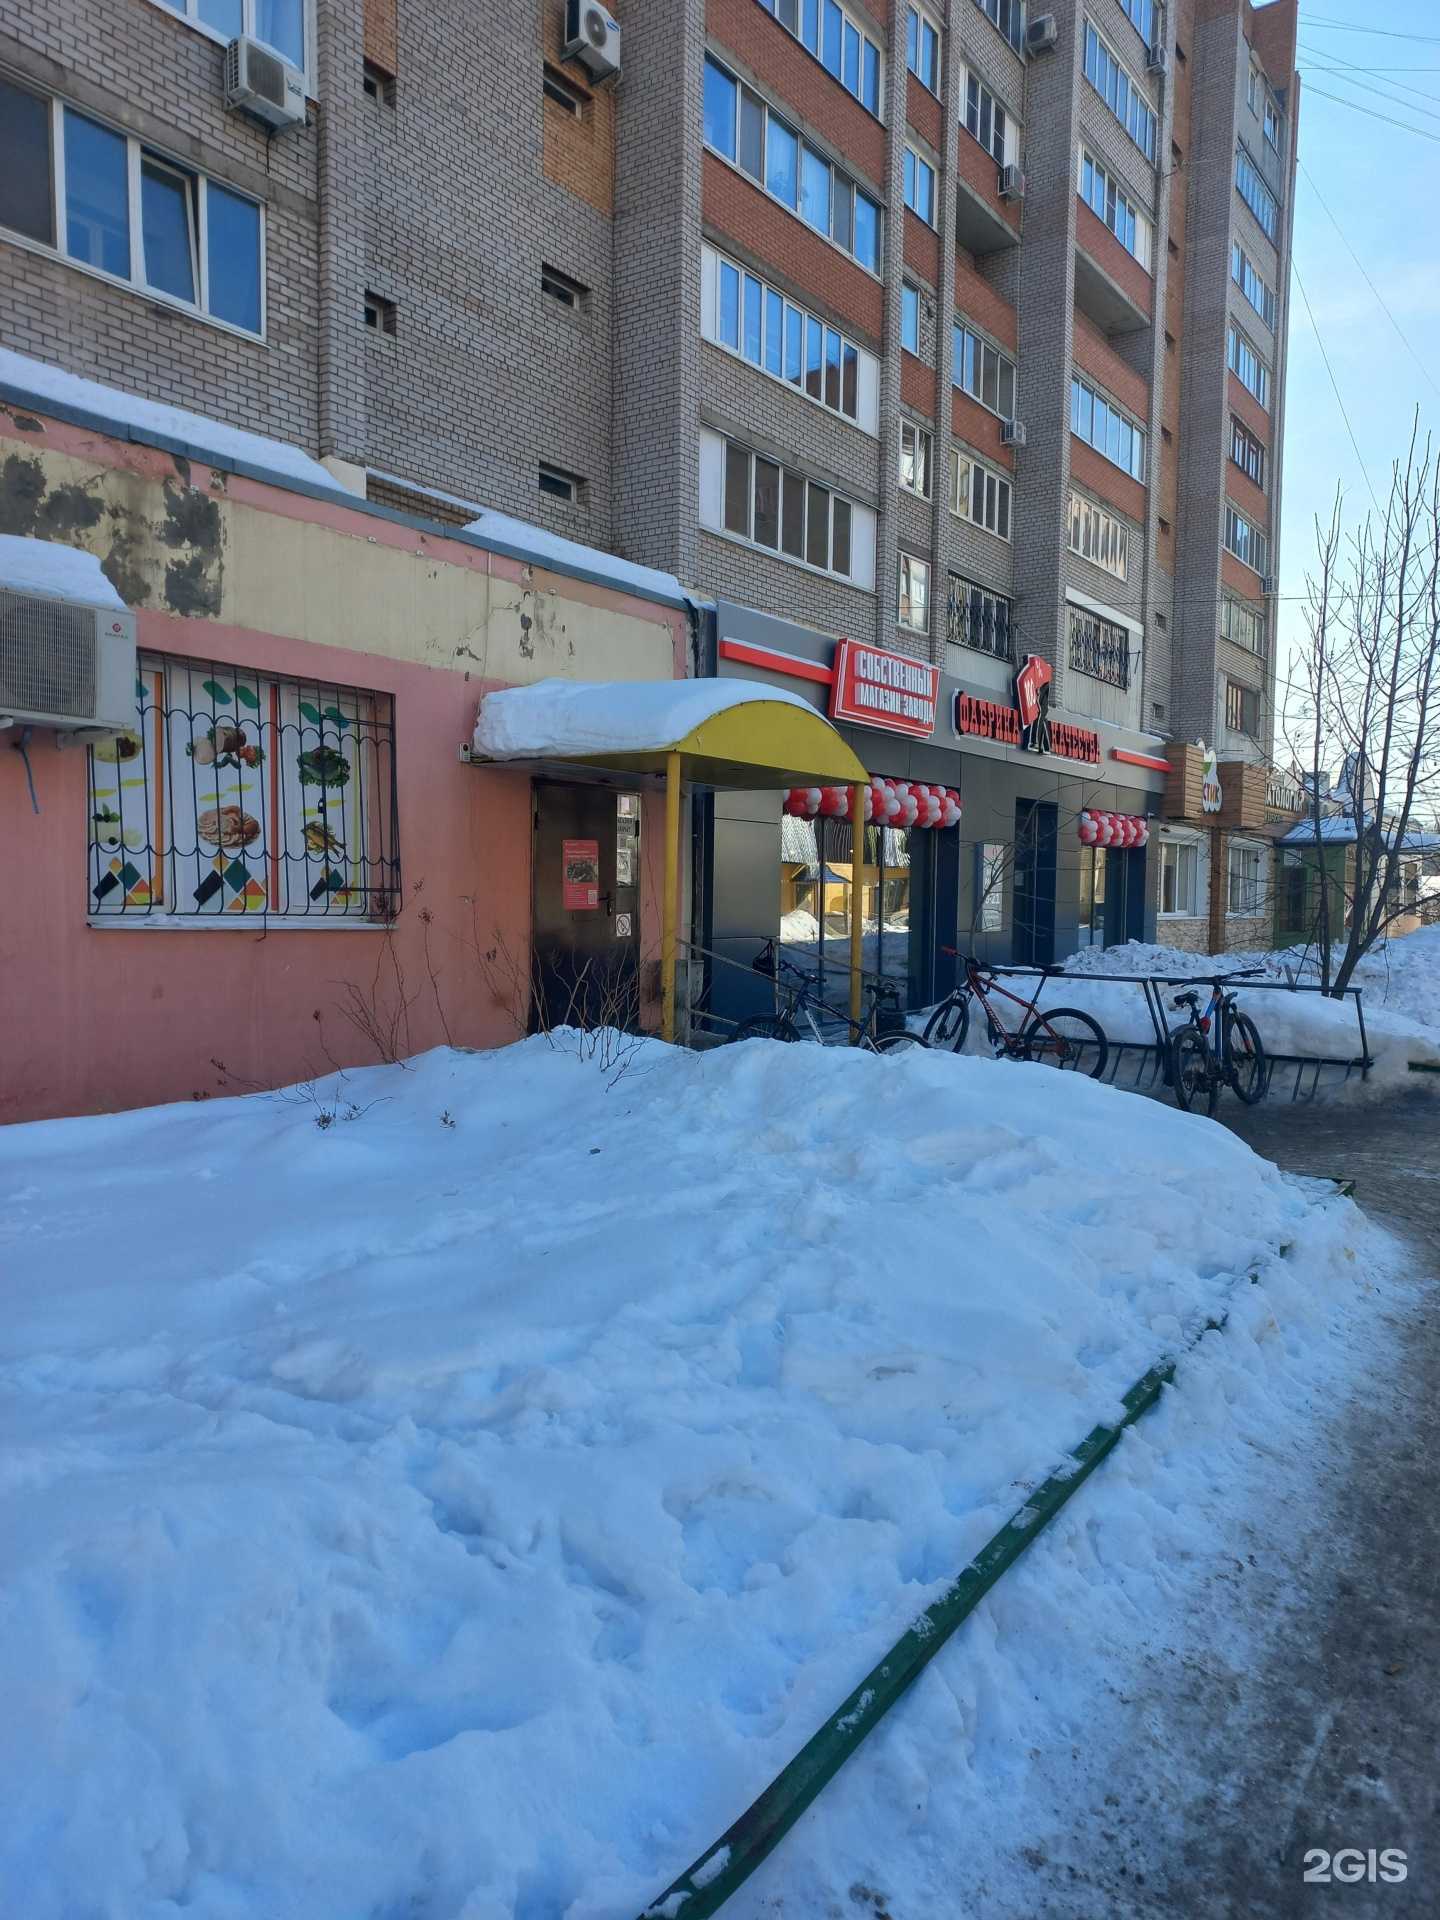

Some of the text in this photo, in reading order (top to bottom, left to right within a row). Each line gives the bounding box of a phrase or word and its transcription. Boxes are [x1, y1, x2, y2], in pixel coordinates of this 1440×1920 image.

[855, 650, 933, 698] СОБСТВЕННЫЙ
[855, 681, 935, 725] МАГАЗИН ЗАВОДА
[956, 691, 1104, 764] ФАБРИКА КАЧЕСТВА
